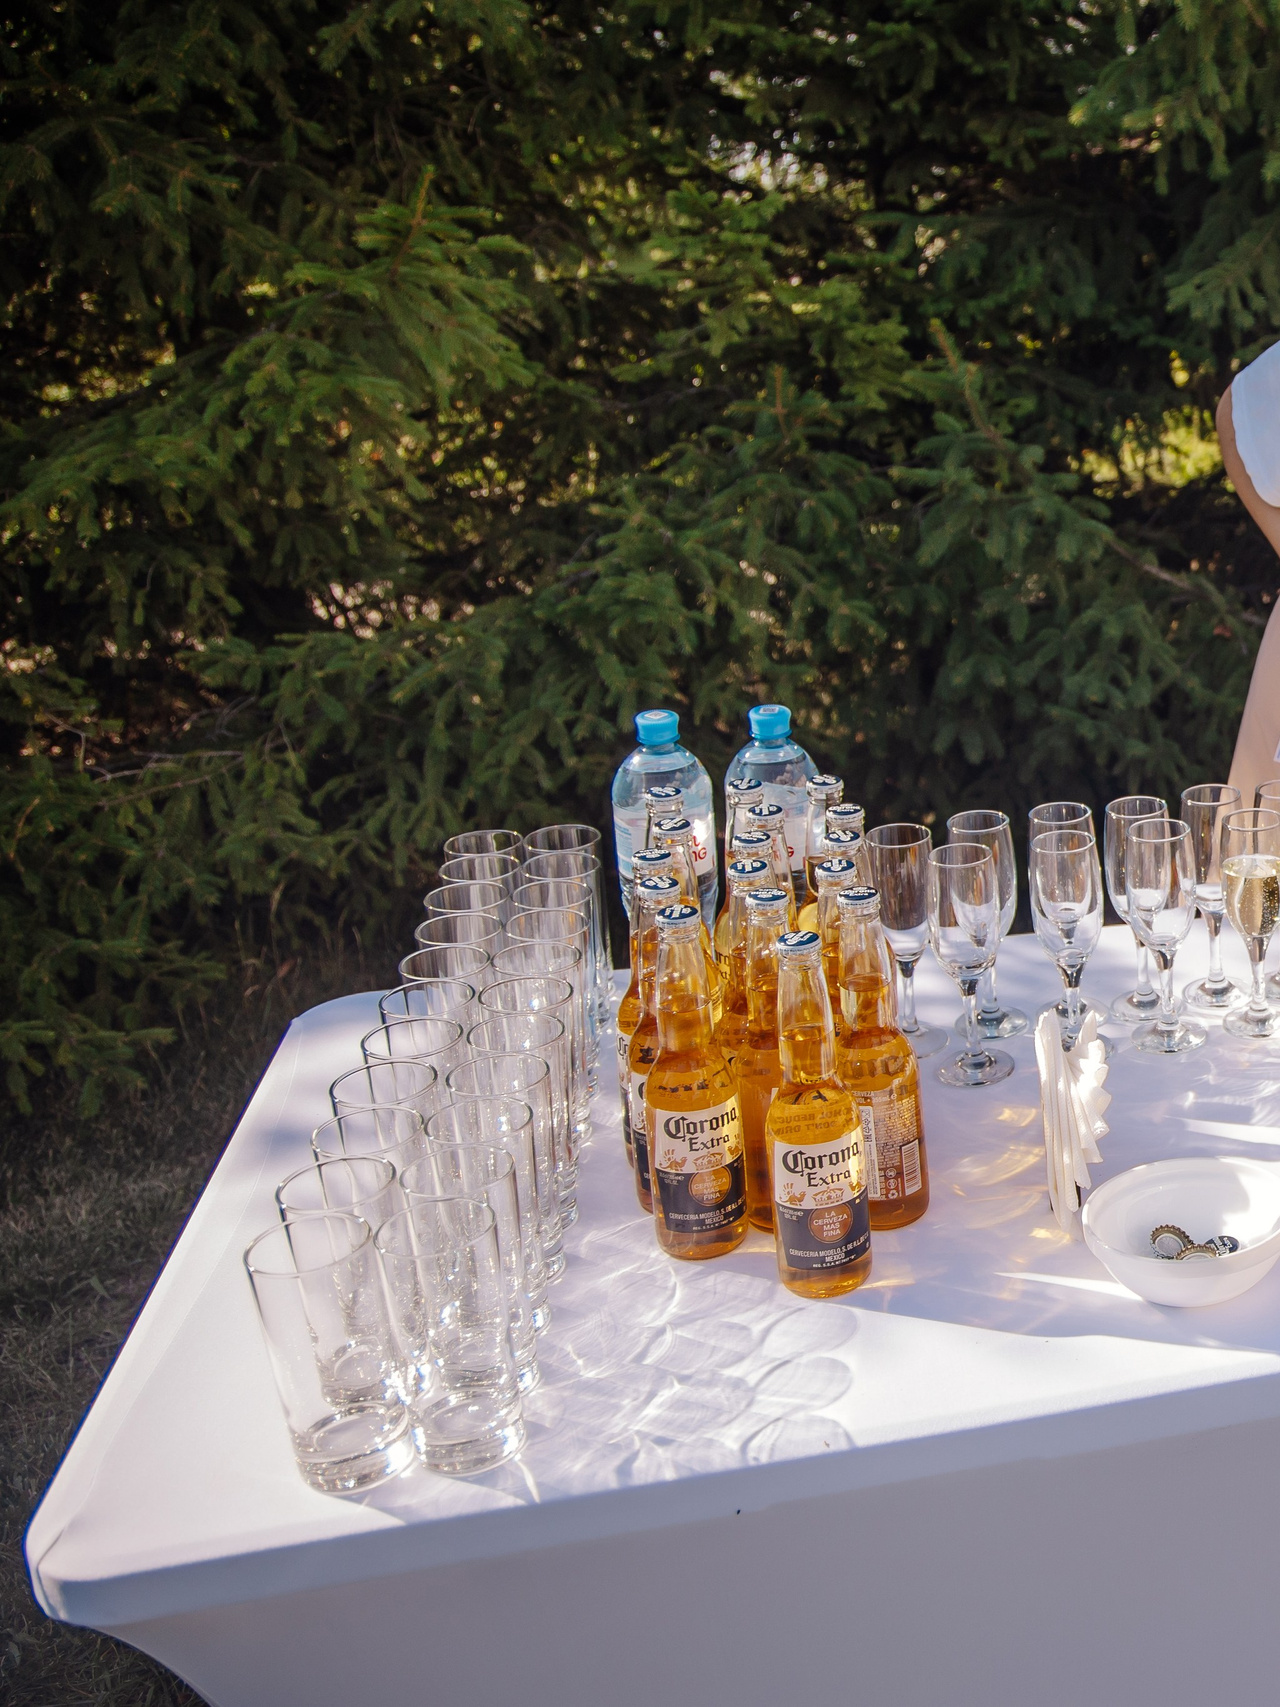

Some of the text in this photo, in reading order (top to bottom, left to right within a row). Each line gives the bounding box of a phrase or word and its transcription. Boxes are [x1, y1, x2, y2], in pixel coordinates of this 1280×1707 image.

[664, 1106, 738, 1142] Corona
[688, 1134, 730, 1152] Extra
[782, 1141, 860, 1177] Corona
[693, 1177, 727, 1190] CERVEZA
[807, 1170, 851, 1188] Extra
[813, 1214, 848, 1226] CERVEZA
[825, 1210, 836, 1219] LA
[824, 1223, 840, 1231] MAS
[824, 1229, 842, 1238] FINA
[789, 1248, 819, 1258] CERVECERIA
[826, 1252, 846, 1262] MEXICO
